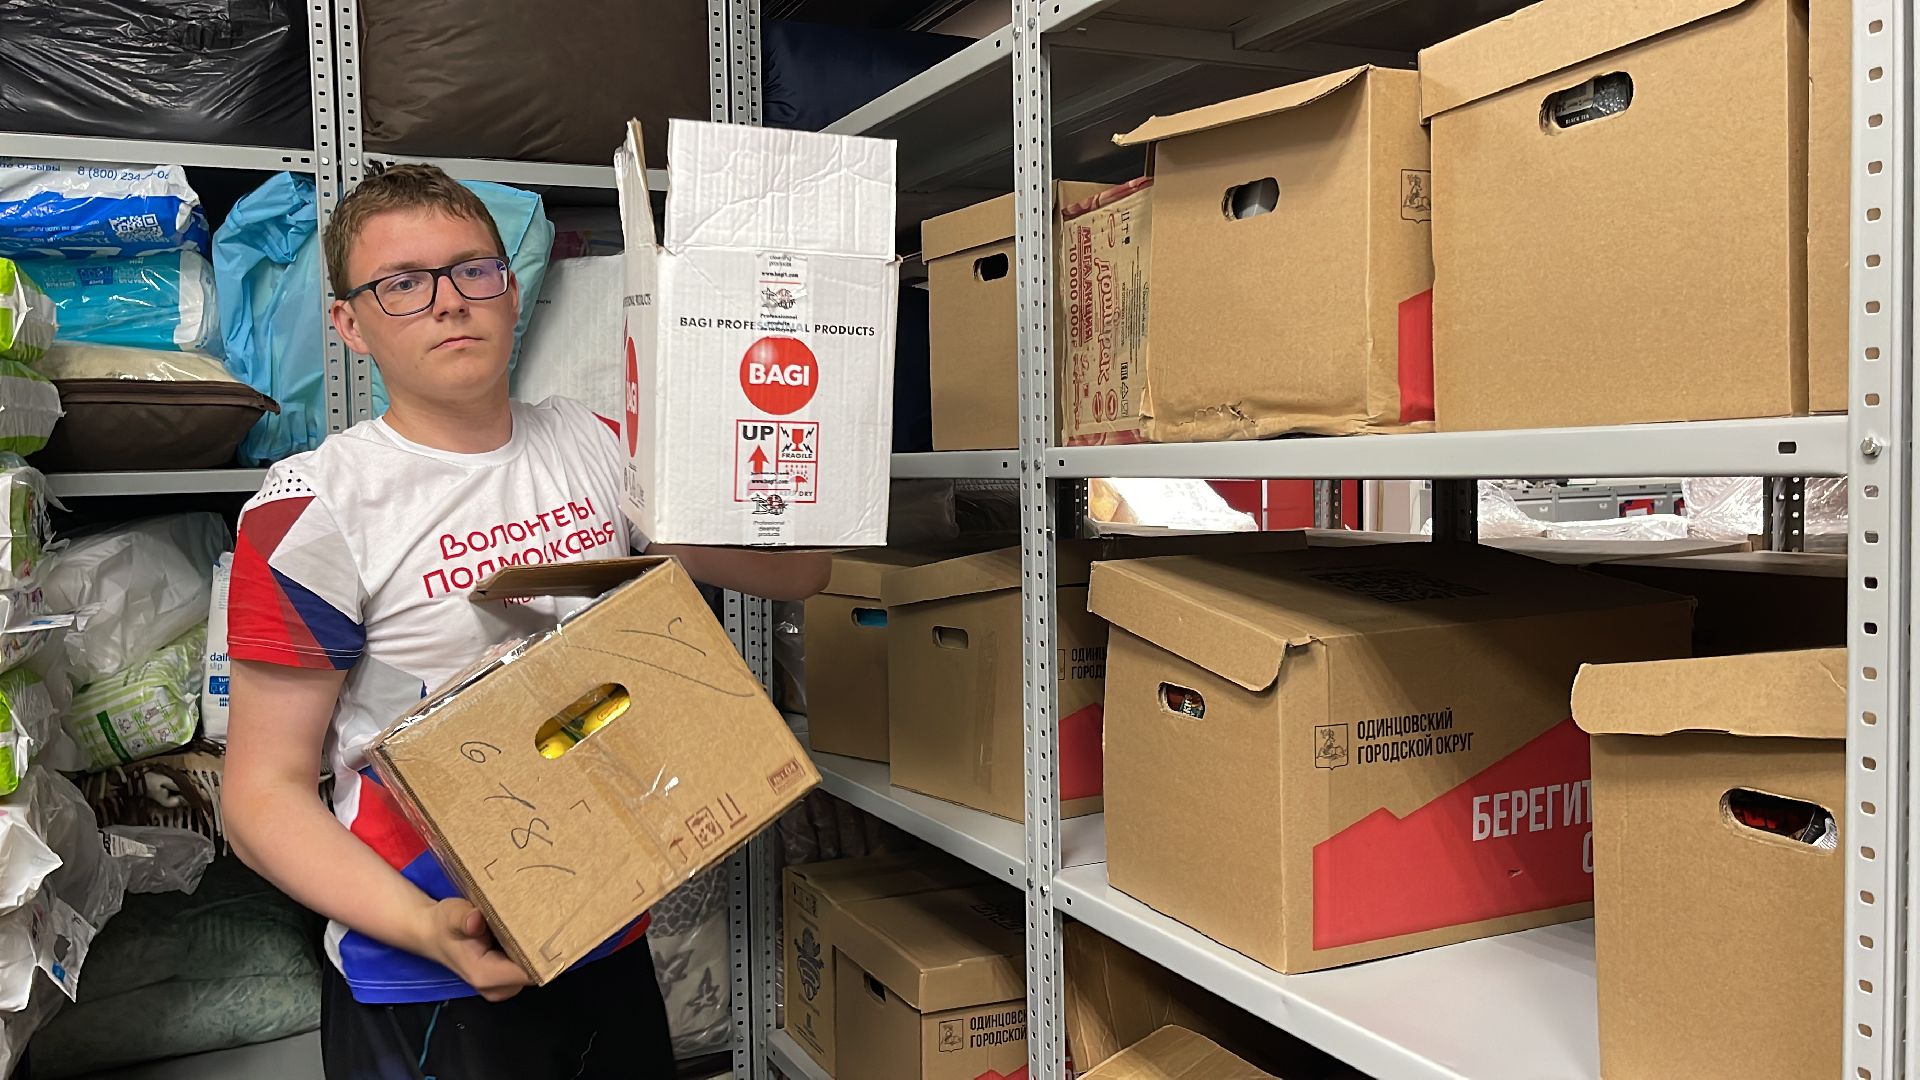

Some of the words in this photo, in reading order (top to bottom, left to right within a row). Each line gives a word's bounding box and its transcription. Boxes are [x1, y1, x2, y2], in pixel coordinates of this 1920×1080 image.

[88, 167, 118, 180] (800)
[1069, 243, 1078, 263] 10
[1082, 226, 1093, 279] МЕГА
[1083, 280, 1093, 342] АКЦИЯ
[680, 316, 713, 329] BAGI
[814, 323, 876, 337] PRODUCTS
[749, 363, 811, 387] BAGI
[743, 425, 775, 441] UP
[1357, 707, 1453, 740] ОДИНЦОВСКИЙ
[1357, 734, 1434, 765] ГОРОДСКОЙ
[1436, 732, 1475, 755] ОКРУГ
[970, 1025, 1028, 1049] ГОРОДСКОЙ
